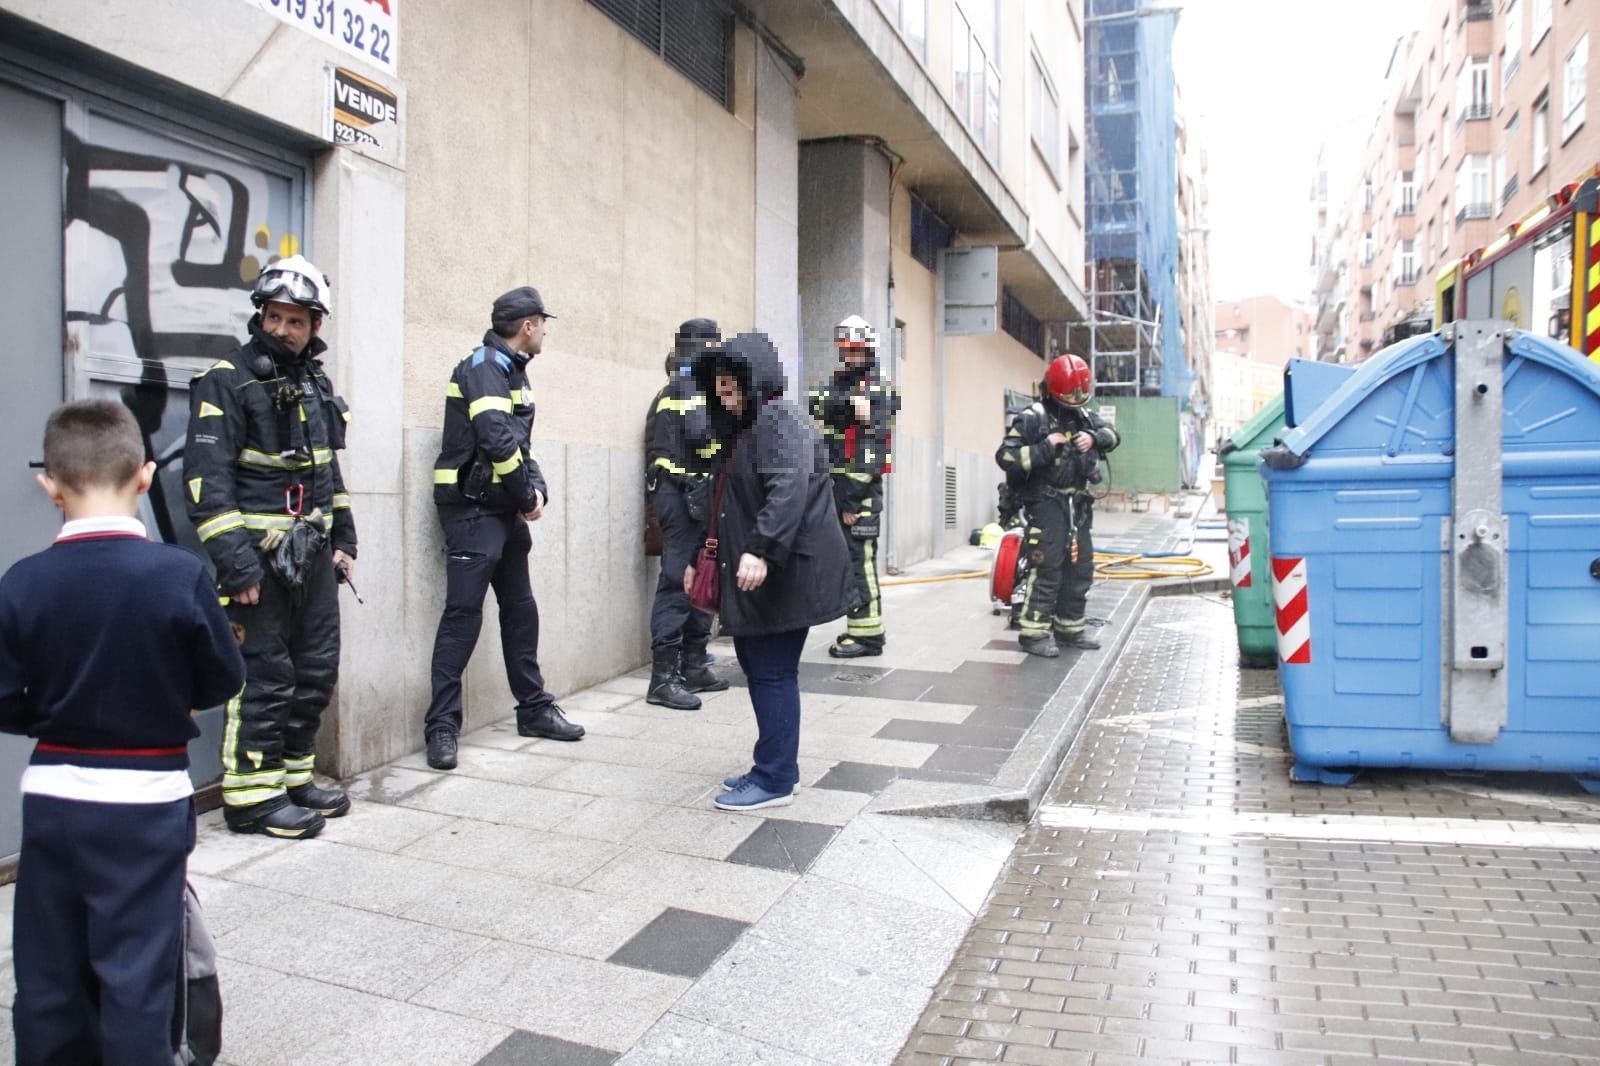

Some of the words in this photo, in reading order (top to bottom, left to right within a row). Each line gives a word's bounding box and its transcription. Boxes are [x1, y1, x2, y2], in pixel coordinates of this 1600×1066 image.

[313, 0, 335, 35] 31
[343, 8, 365, 50] 32
[370, 23, 390, 64] 22
[335, 79, 397, 124] VENDE
[335, 122, 356, 143] 923
